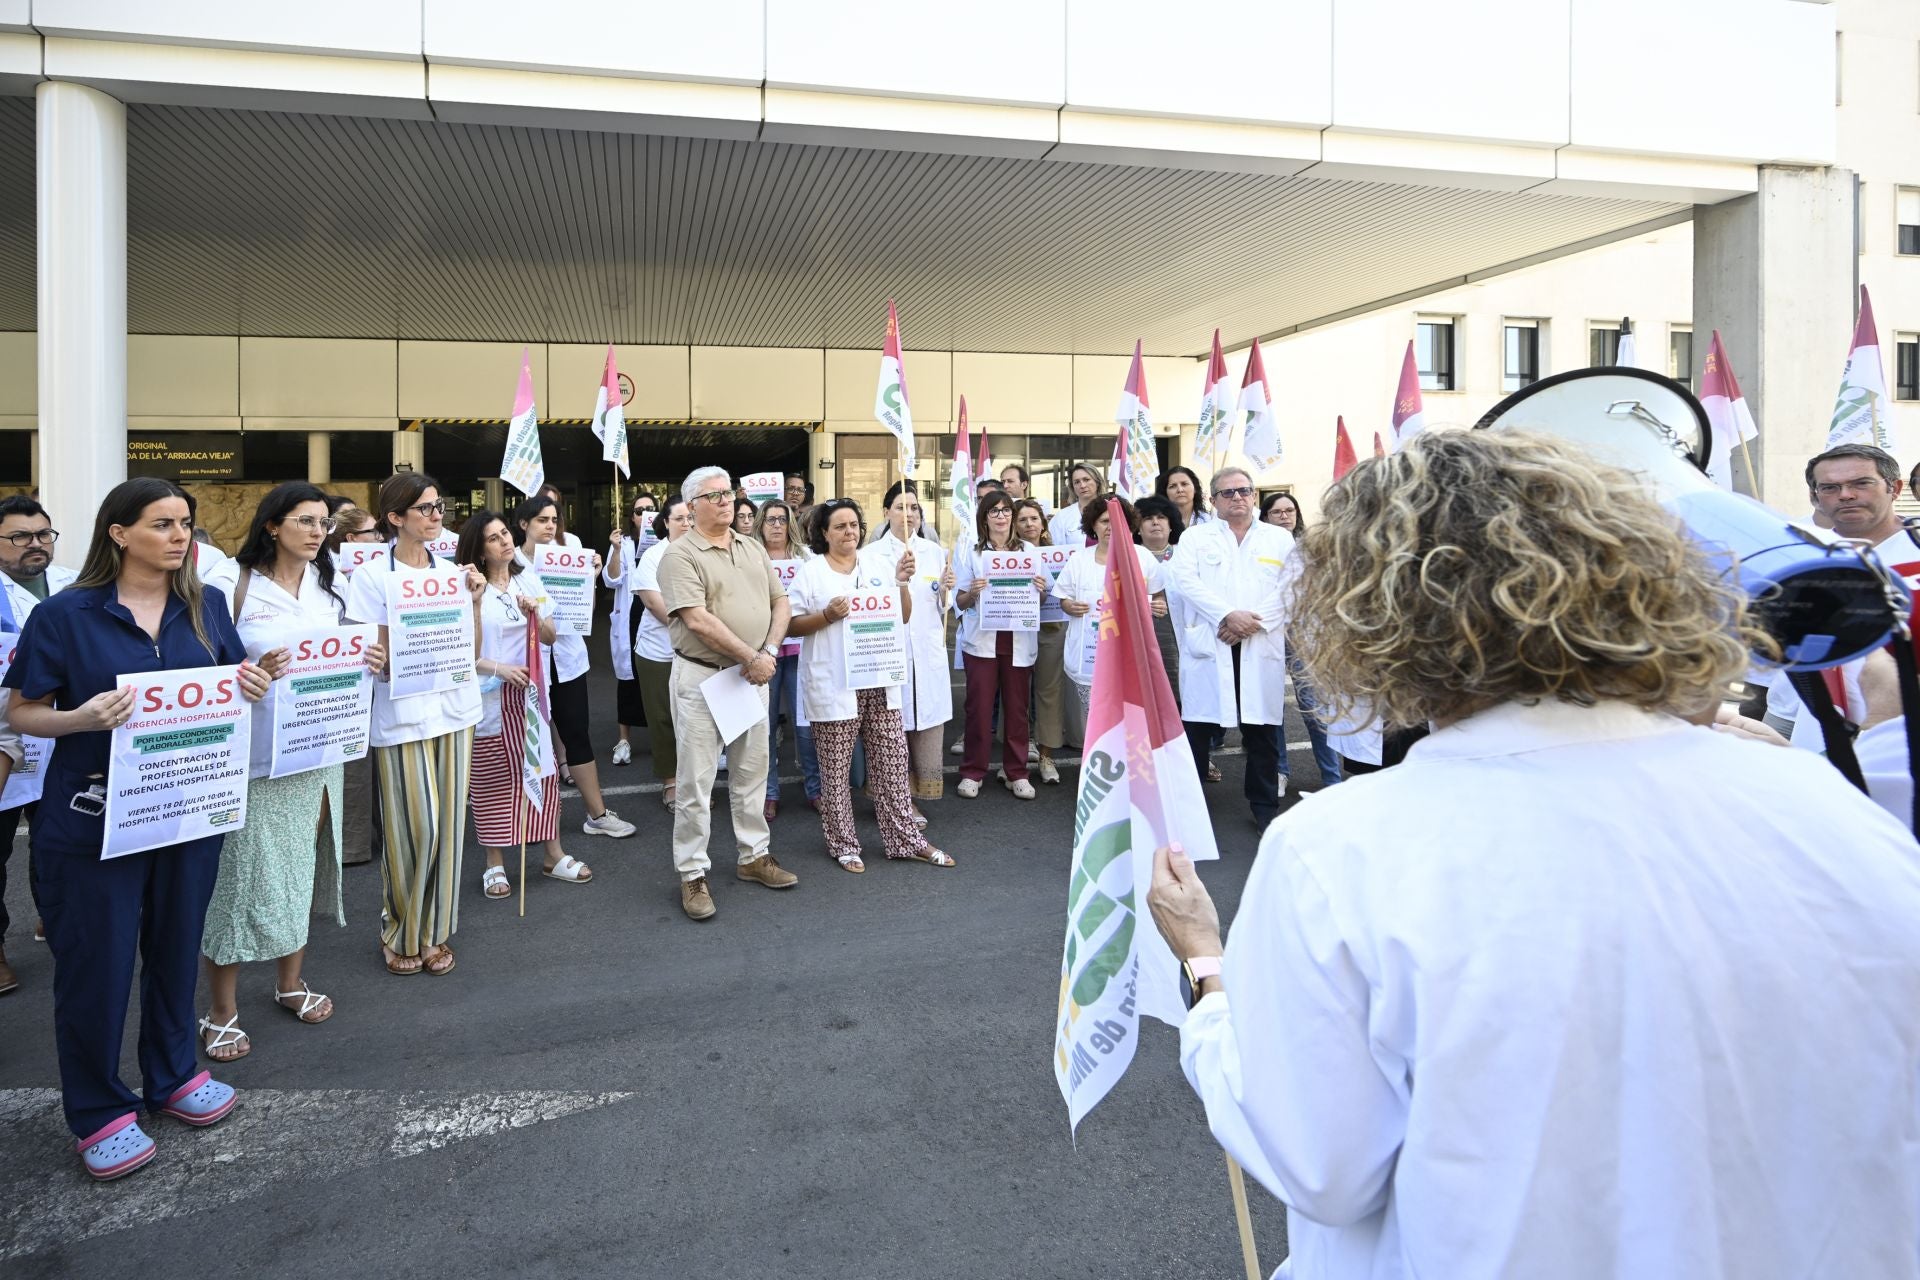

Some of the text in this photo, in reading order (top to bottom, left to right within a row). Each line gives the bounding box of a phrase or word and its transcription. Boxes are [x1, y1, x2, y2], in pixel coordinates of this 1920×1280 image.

[748, 476, 777, 487] S.O.S
[544, 552, 586, 568] S.O.S
[992, 558, 1032, 570] S.O.S
[402, 578, 458, 598] S.O.S
[852, 595, 891, 611] S.O.S
[406, 629, 454, 640] CONCENTRACIÓN
[408, 637, 453, 647] PROFESIONALES
[296, 636, 363, 661] S.O.S
[396, 642, 471, 657] URGENCIAS HOSPITALARIAS
[322, 674, 360, 683] CONDICIONES
[143, 679, 232, 712] S.O.S
[299, 683, 332, 693] LABORALES
[295, 695, 350, 709] CONCENTRACIÓN
[297, 704, 348, 717] PROFESIONALES
[125, 709, 242, 730] URGENCIAS HOSPITALARIAS
[282, 709, 368, 729] URGENCIAS HOSPITALARIAS
[144, 734, 224, 751] LABORALES JUSTAS
[156, 734, 178, 742] UNAS
[180, 727, 232, 739] CONDICIONES
[288, 736, 311, 745] VIERNES
[326, 731, 342, 739] JULIO
[282, 733, 365, 755] HOSPITAL MORALES MESEGUER
[139, 752, 218, 771] CONCENTRACIÓN
[141, 763, 214, 782] PROFESIONALES
[120, 768, 244, 797] URGENCIAS HOSPITALARIAS
[127, 805, 161, 817] VIERNES
[184, 796, 205, 807] JULIO
[207, 792, 226, 800] 10:00
[118, 798, 241, 829] HOSPITAL MORALES MESEGUER
